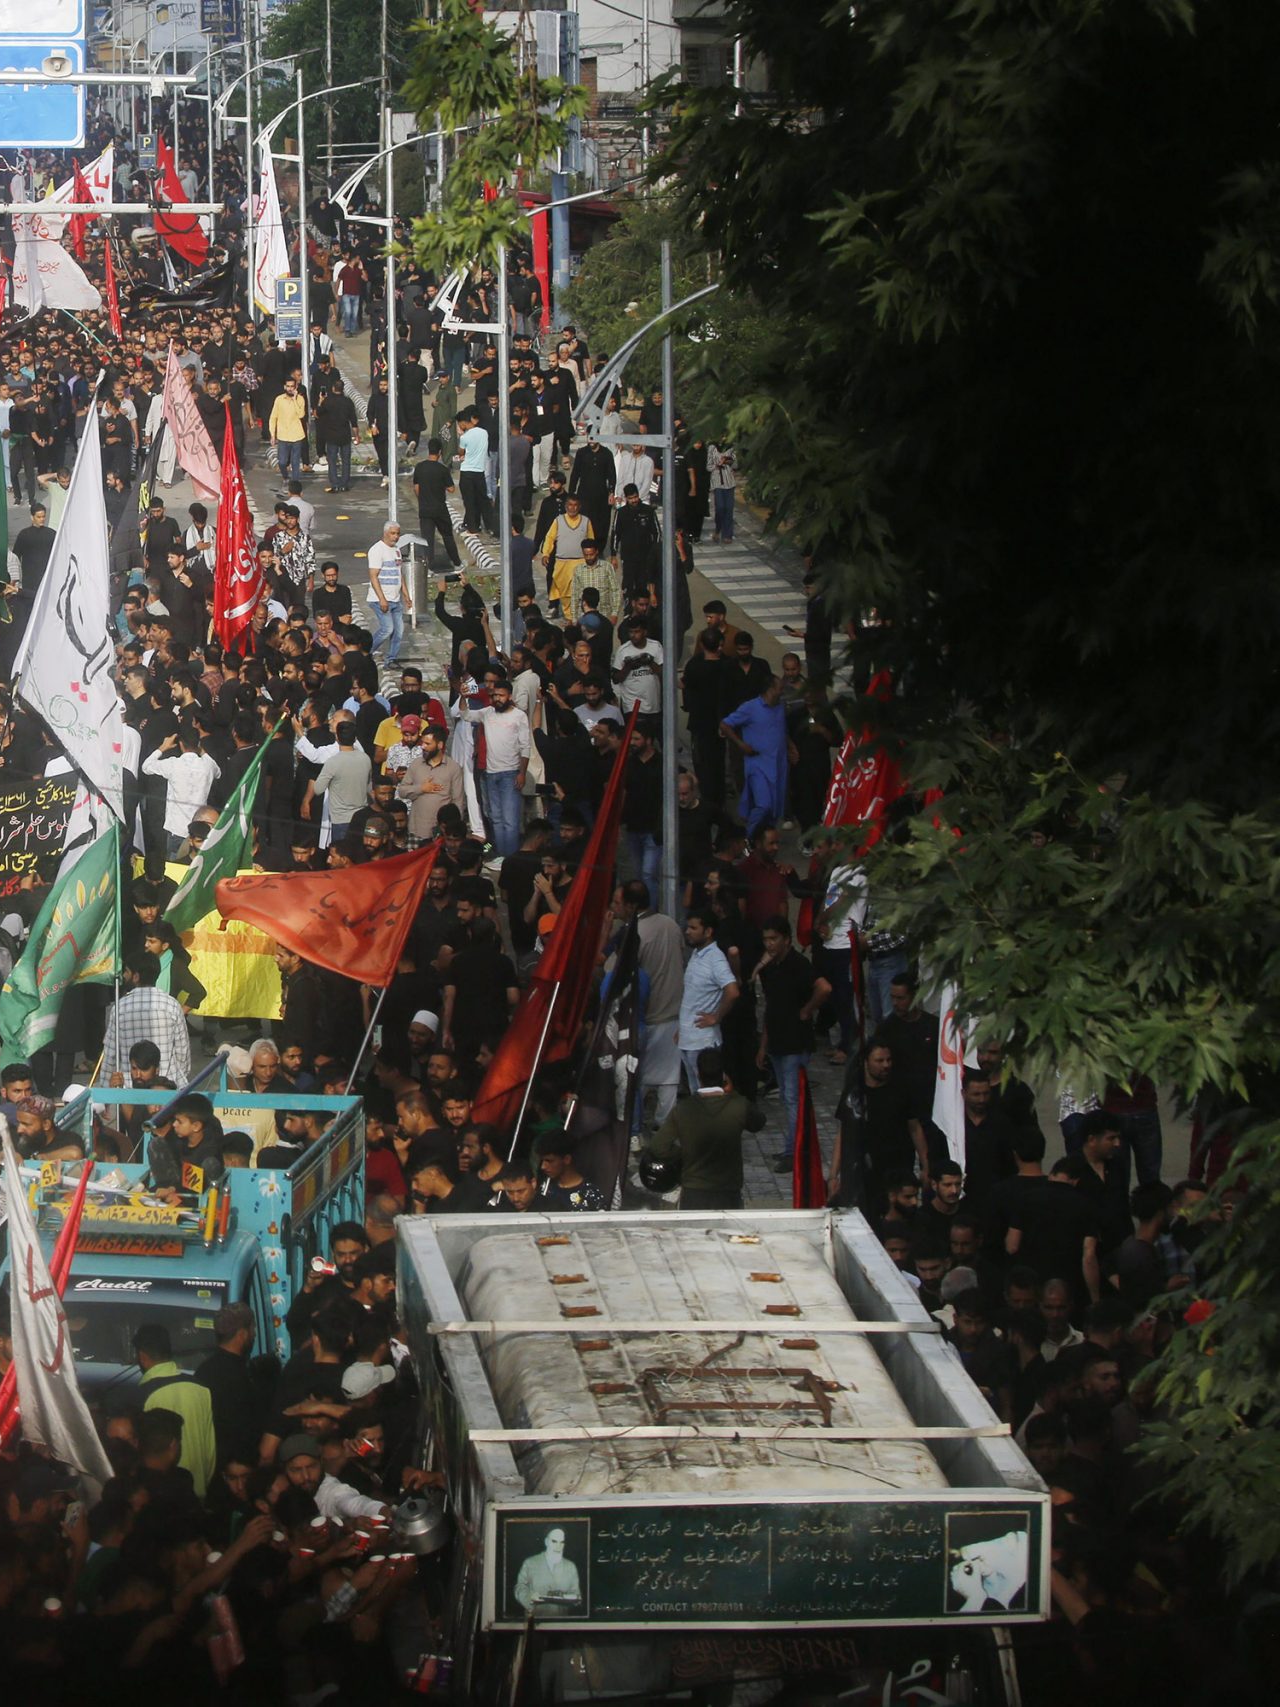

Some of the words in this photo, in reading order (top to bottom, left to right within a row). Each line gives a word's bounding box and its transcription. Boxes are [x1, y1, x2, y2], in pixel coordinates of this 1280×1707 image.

[143, 137, 152, 148] P
[284, 282, 298, 301] P
[642, 1602, 687, 1612] CONTACT
